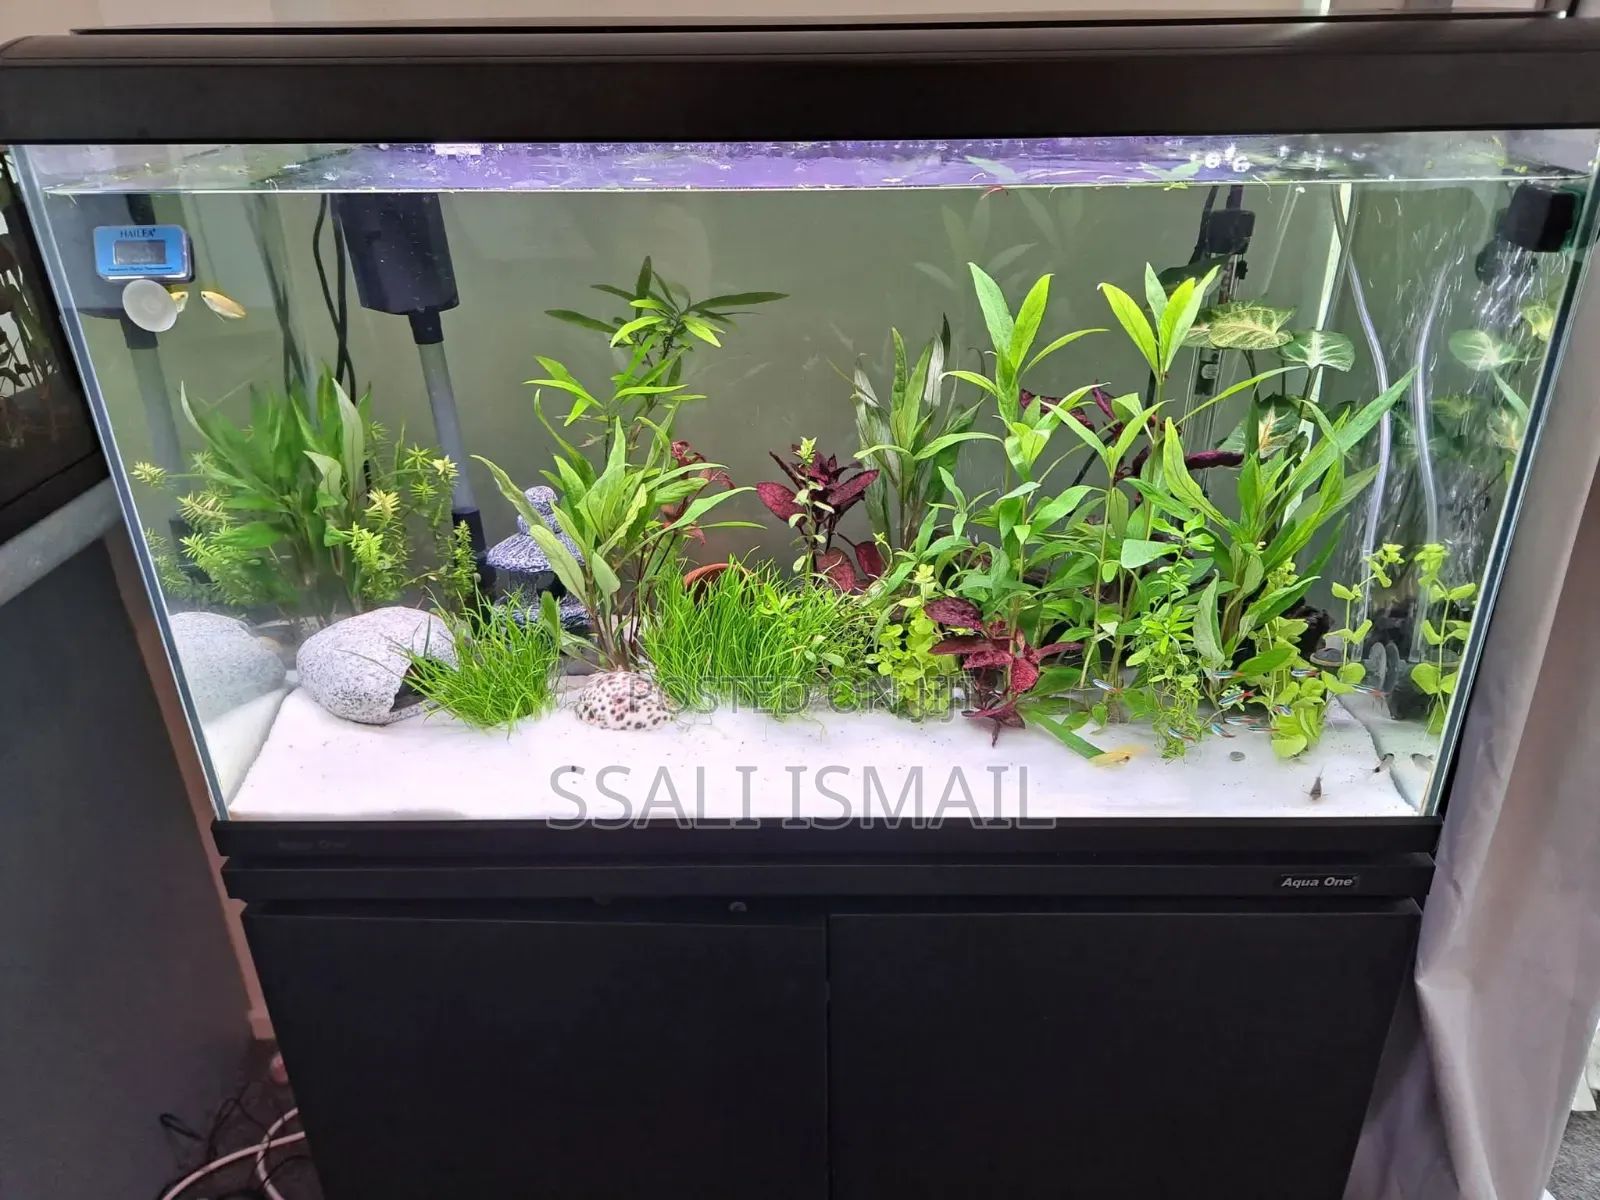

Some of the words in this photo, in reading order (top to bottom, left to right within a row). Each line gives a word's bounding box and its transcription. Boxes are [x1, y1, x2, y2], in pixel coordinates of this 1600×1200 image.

[120, 229, 155, 238] HAILEA
[1280, 877, 1320, 889] Aqua
[1323, 876, 1353, 887] One
